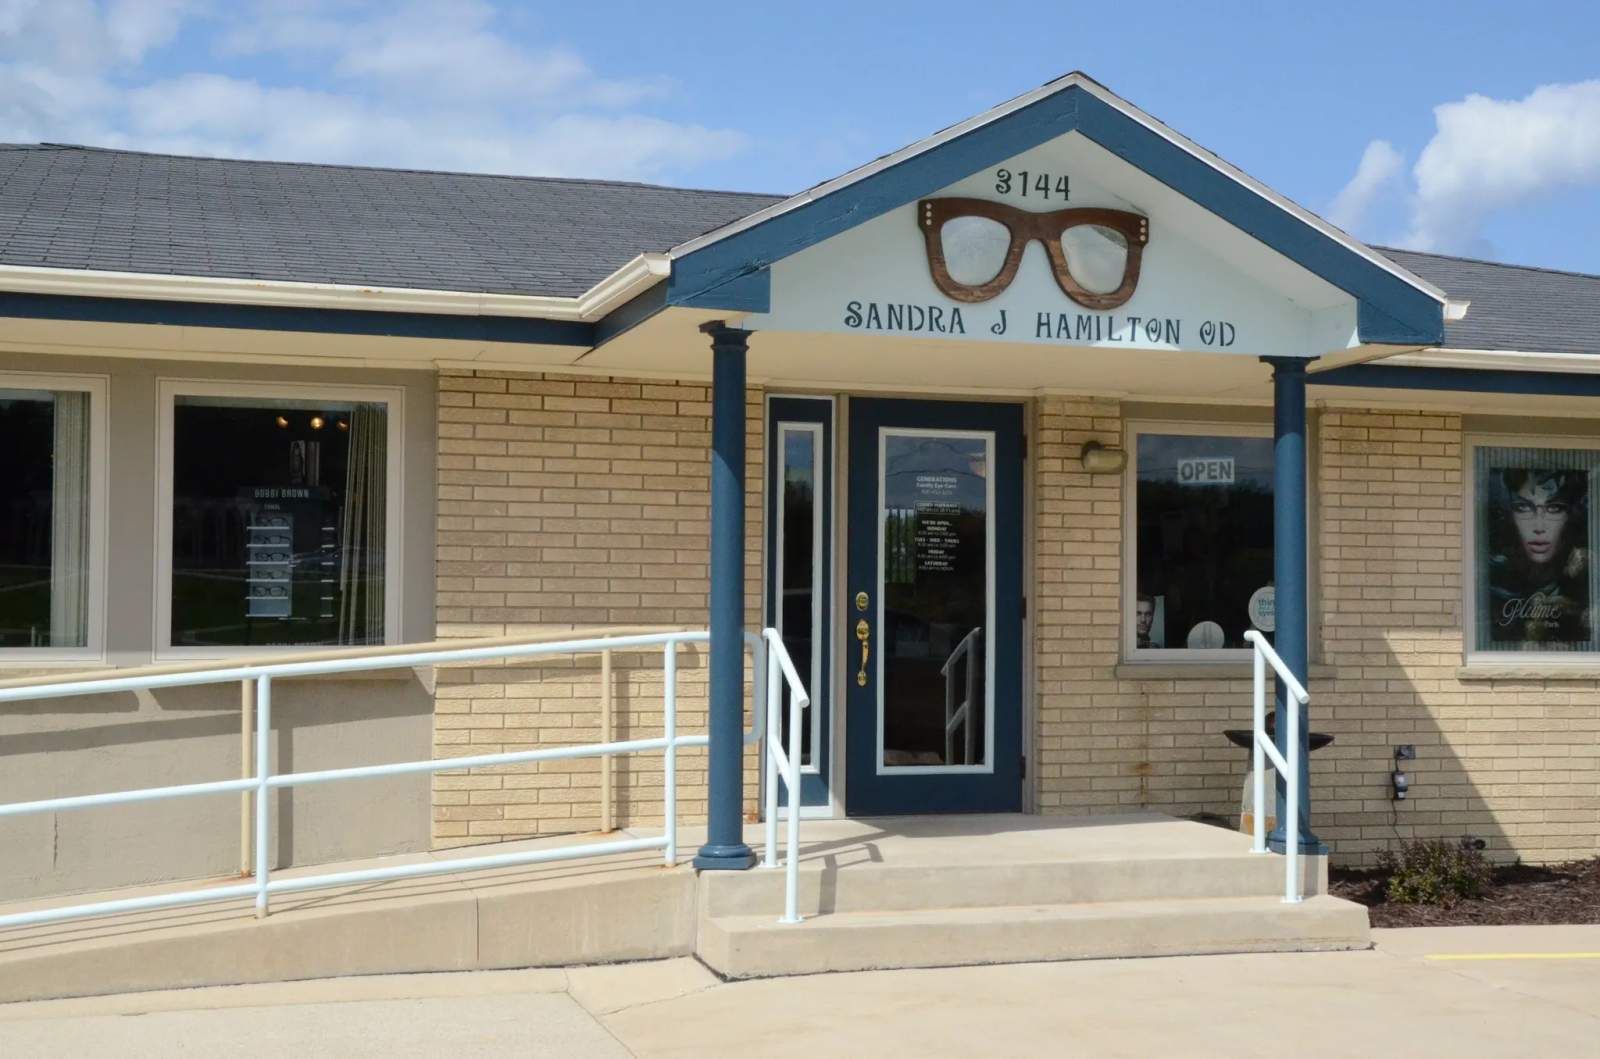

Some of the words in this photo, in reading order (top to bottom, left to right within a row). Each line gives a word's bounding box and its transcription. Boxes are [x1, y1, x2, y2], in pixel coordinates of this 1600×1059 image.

[995, 168, 1071, 200] 3144
[844, 300, 967, 334] SANDRA
[990, 309, 1008, 336] J
[1035, 312, 1182, 345] HAMILTON
[1199, 320, 1236, 347] OD
[1180, 461, 1233, 480] OPEN
